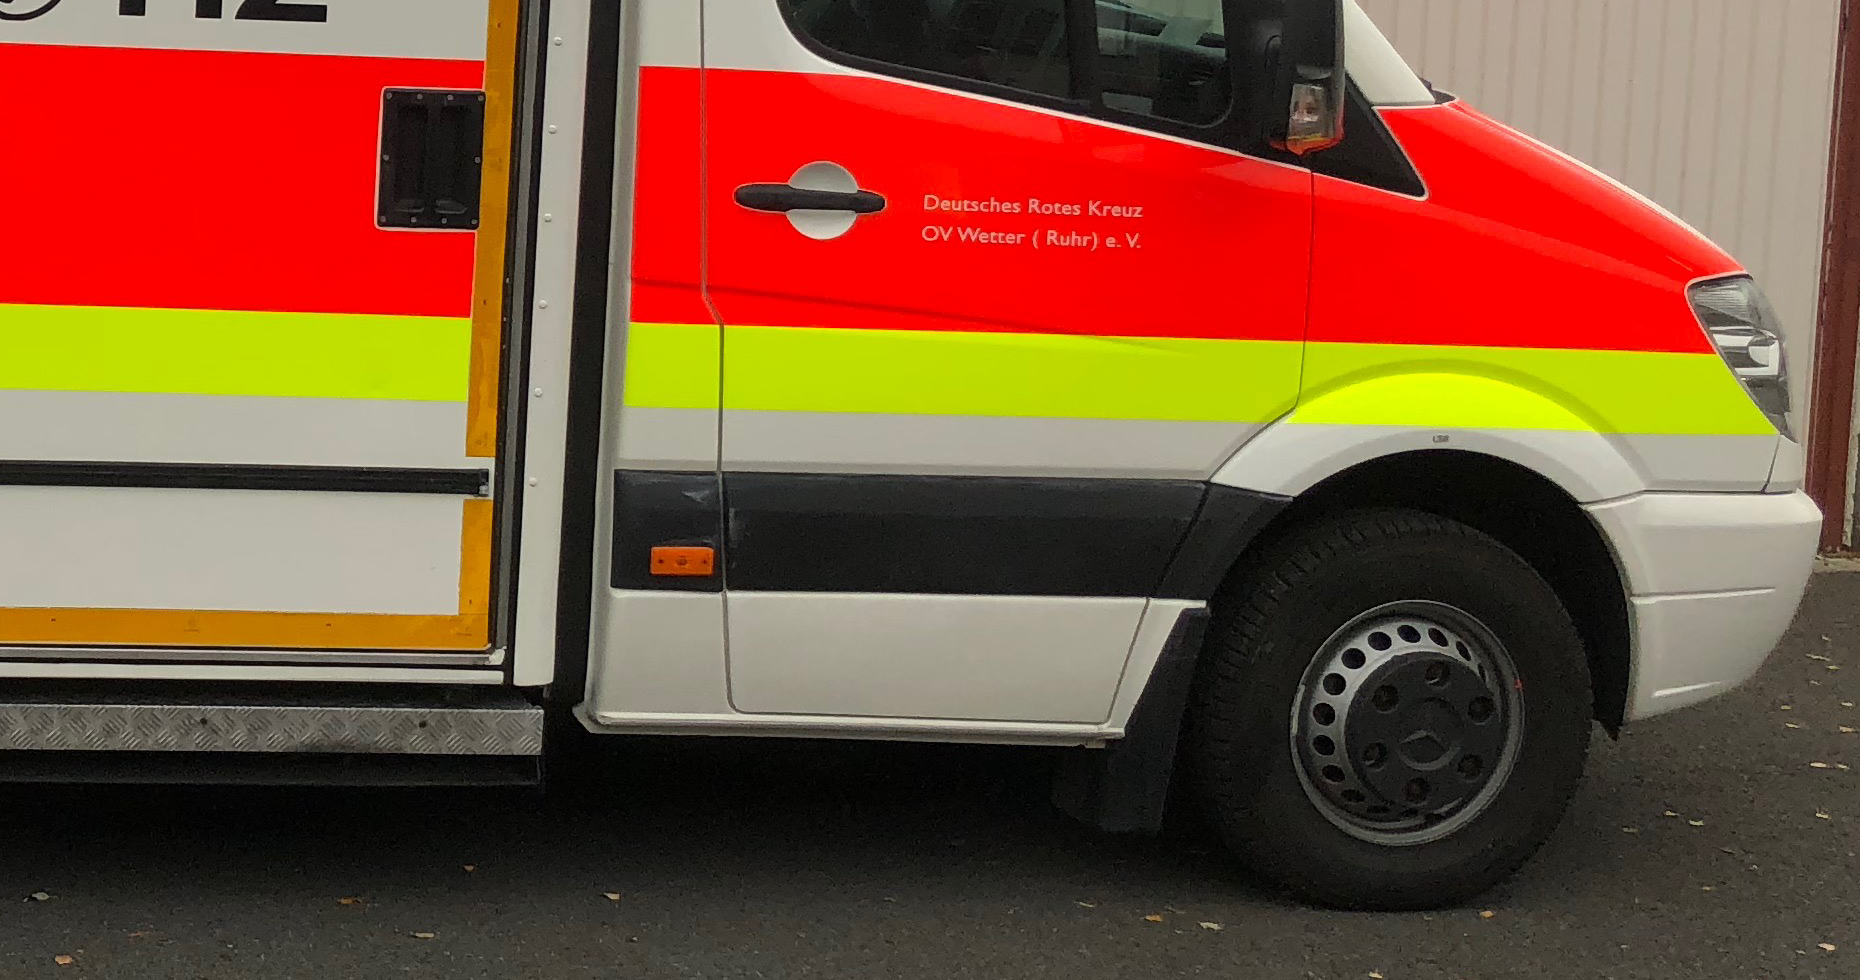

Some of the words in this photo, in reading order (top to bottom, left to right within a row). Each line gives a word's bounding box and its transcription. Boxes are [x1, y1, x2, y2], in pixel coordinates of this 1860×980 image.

[923, 194, 1022, 213] Deutsches
[1028, 198, 1082, 216] Rotes
[1088, 200, 1144, 218] Kreuz
[921, 225, 954, 242] OV
[956, 226, 1027, 245] Wetter
